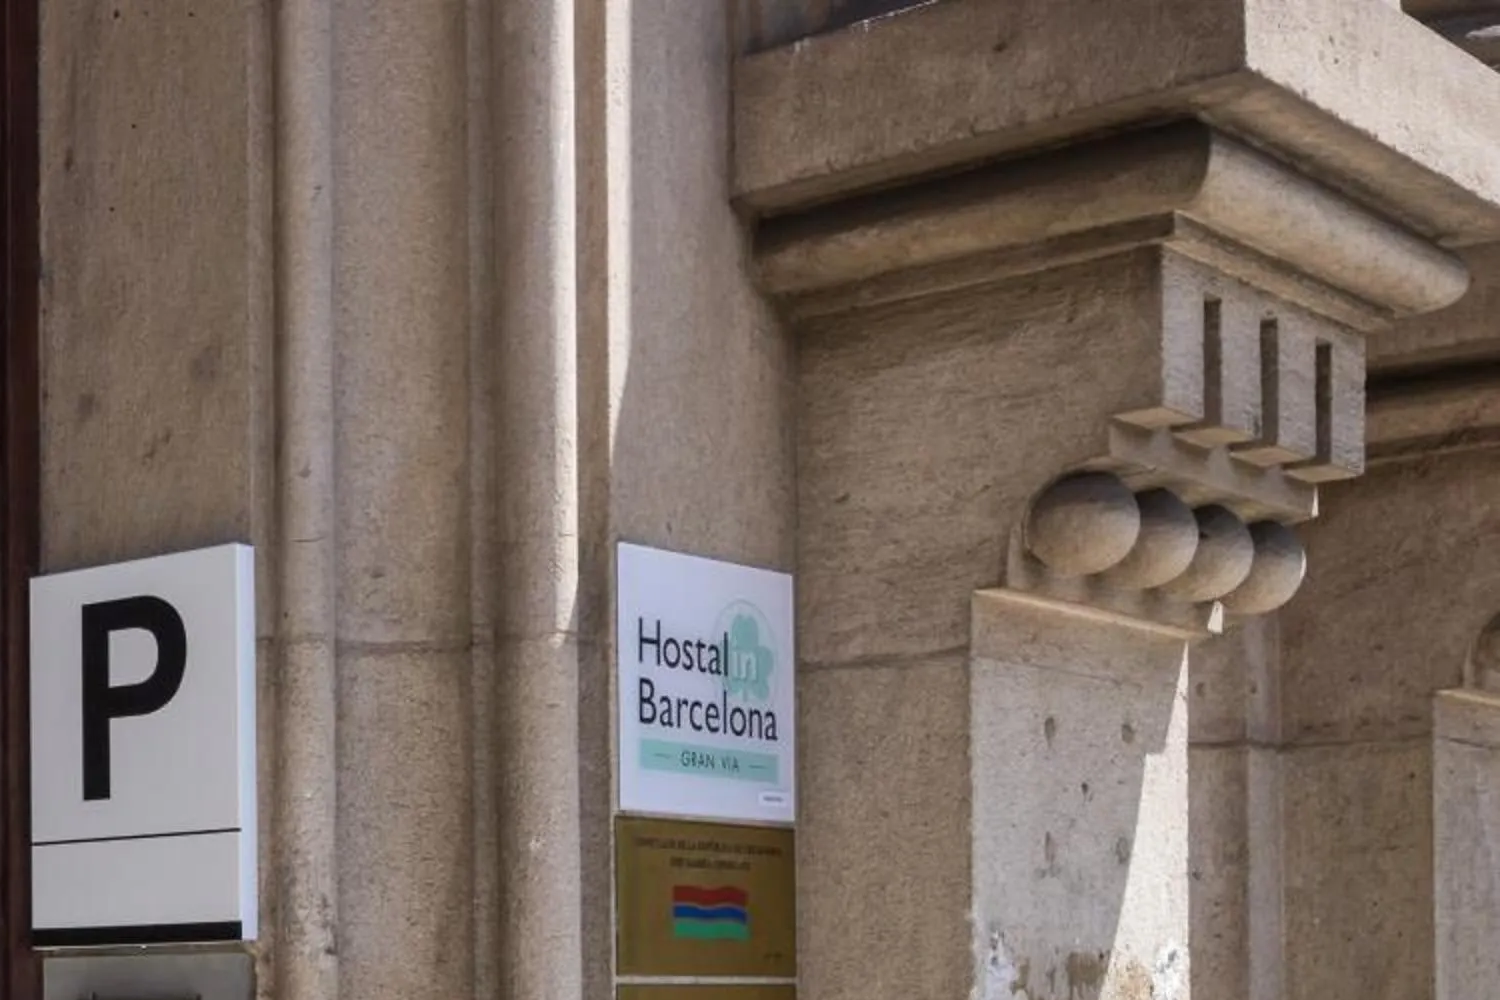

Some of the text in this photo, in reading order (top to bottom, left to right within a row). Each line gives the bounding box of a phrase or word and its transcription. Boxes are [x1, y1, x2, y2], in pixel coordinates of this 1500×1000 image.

[638, 616, 729, 677] Hostal
[82, 595, 188, 801] P
[638, 677, 778, 741] Barcelona
[680, 751, 715, 770] GRAN
